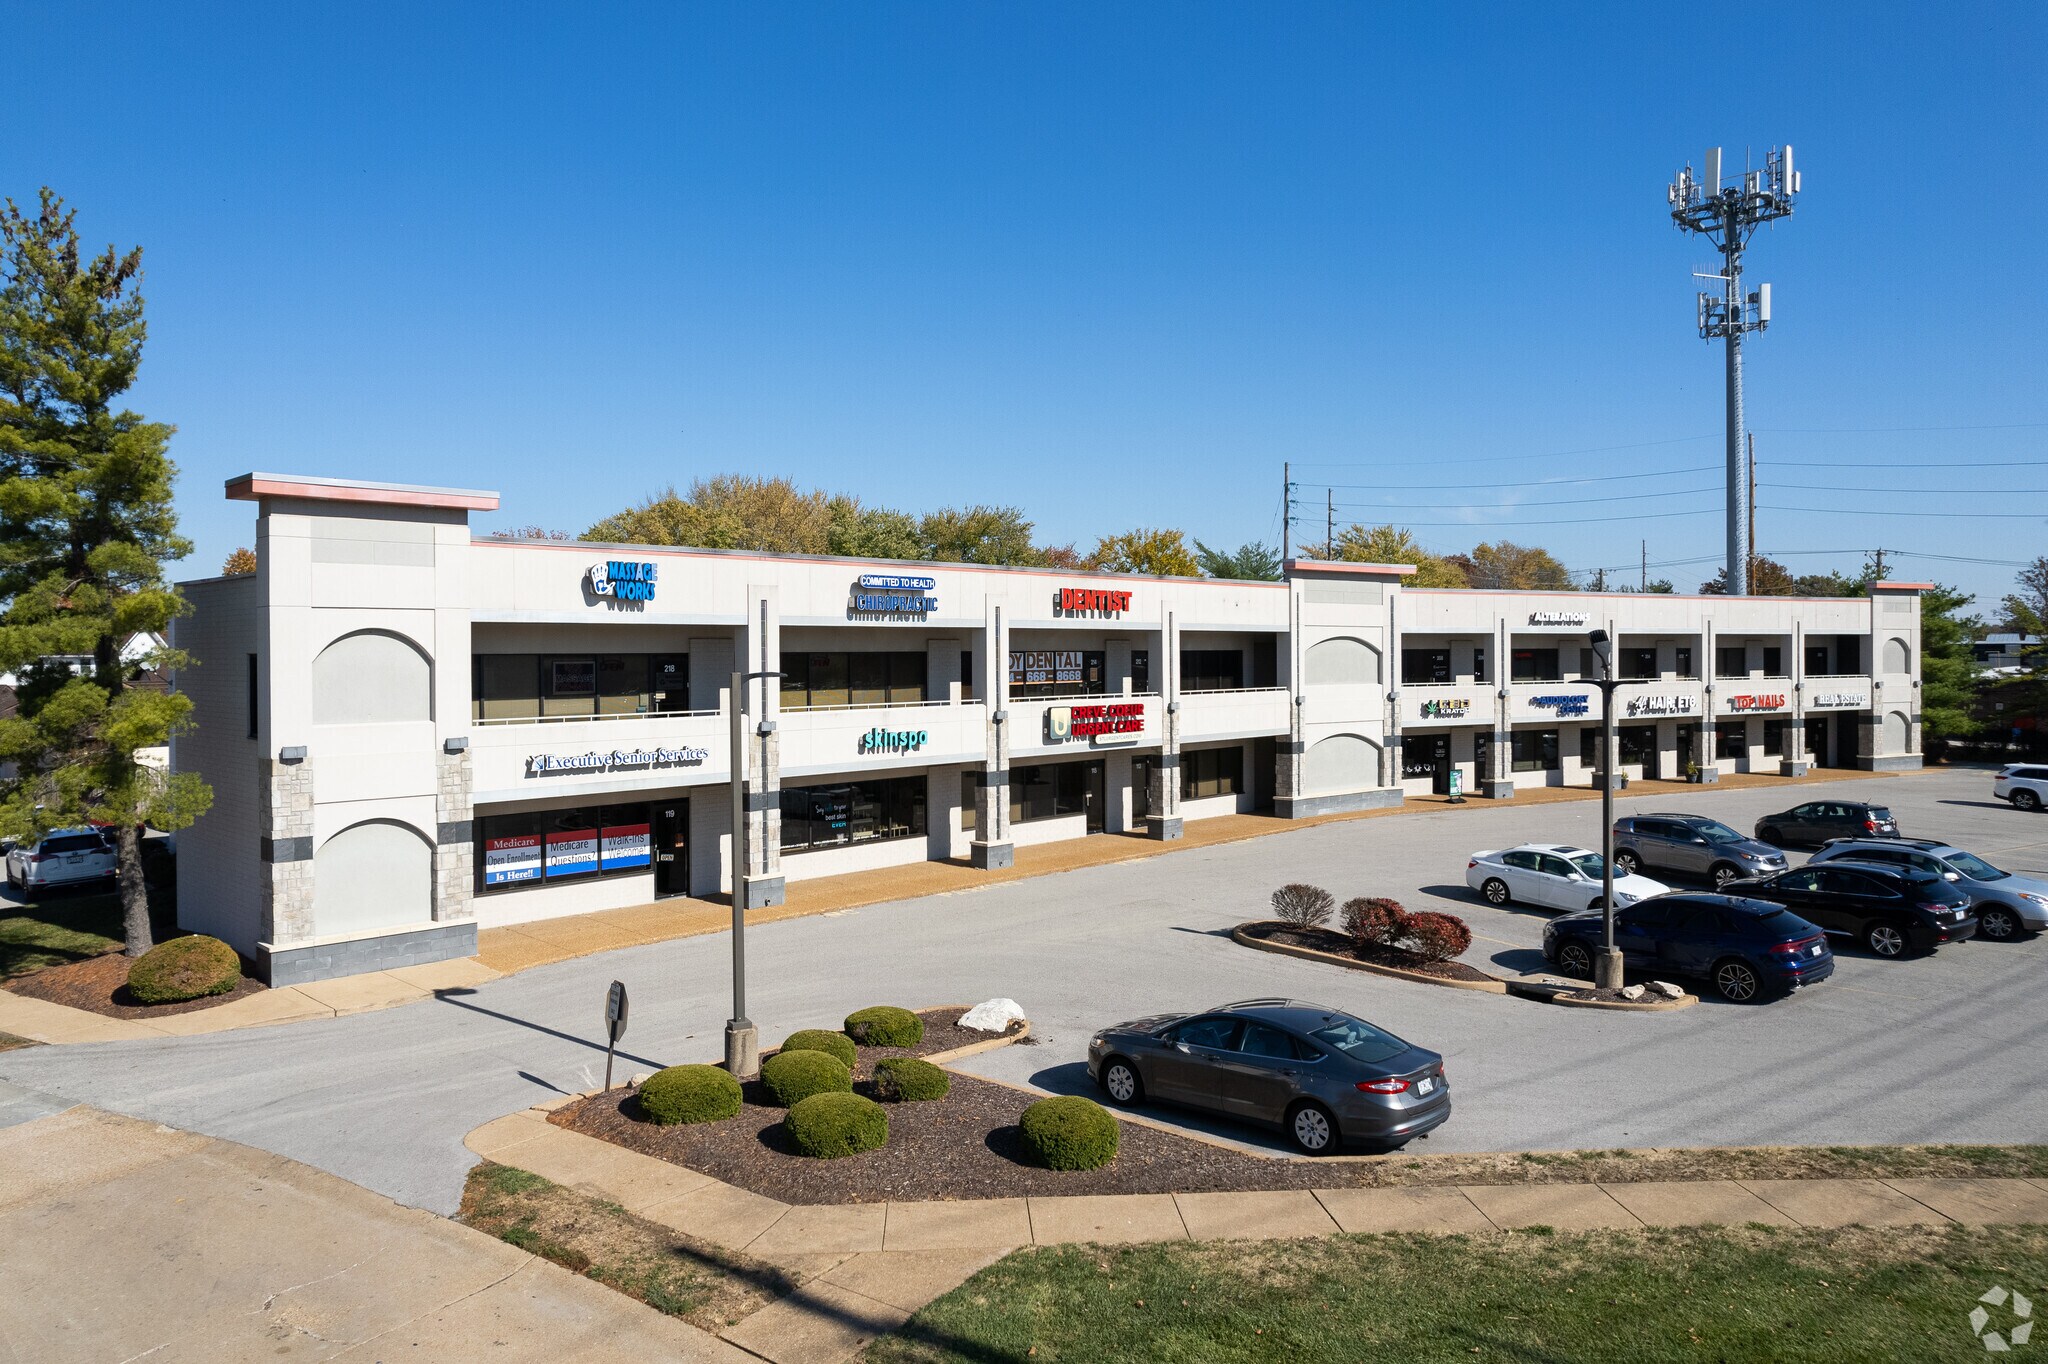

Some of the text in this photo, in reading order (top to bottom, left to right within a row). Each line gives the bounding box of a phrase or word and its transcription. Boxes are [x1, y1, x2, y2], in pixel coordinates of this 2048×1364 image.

[608, 561, 658, 581] MASSAGE
[861, 576, 934, 588] COMMITTED TO HEALTH
[616, 581, 655, 601] WORKS
[857, 594, 938, 611] CHIROPRACTIC
[1062, 588, 1132, 612] DENTIST
[1534, 612, 1591, 621] ALTERATIONS
[1439, 699, 1470, 708] CBD
[1540, 695, 1589, 704] AUDIOLOGY
[1734, 694, 1785, 708] TOP NAILS
[1819, 693, 1867, 703] REAL ESTATE
[1071, 703, 1144, 719] CREVE COEUR
[1560, 705, 1589, 713] CENTER
[1071, 718, 1144, 736] URGENT CARE
[865, 727, 928, 750] skinspa
[547, 746, 709, 769] Executive Senior Services
[493, 838, 535, 849] Medicare
[550, 840, 589, 852] Medicare
[550, 851, 596, 867] Questions?
[608, 845, 646, 859] Welcome!
[488, 851, 540, 868] Open Enrollment
[496, 868, 533, 881] Is Here!!
